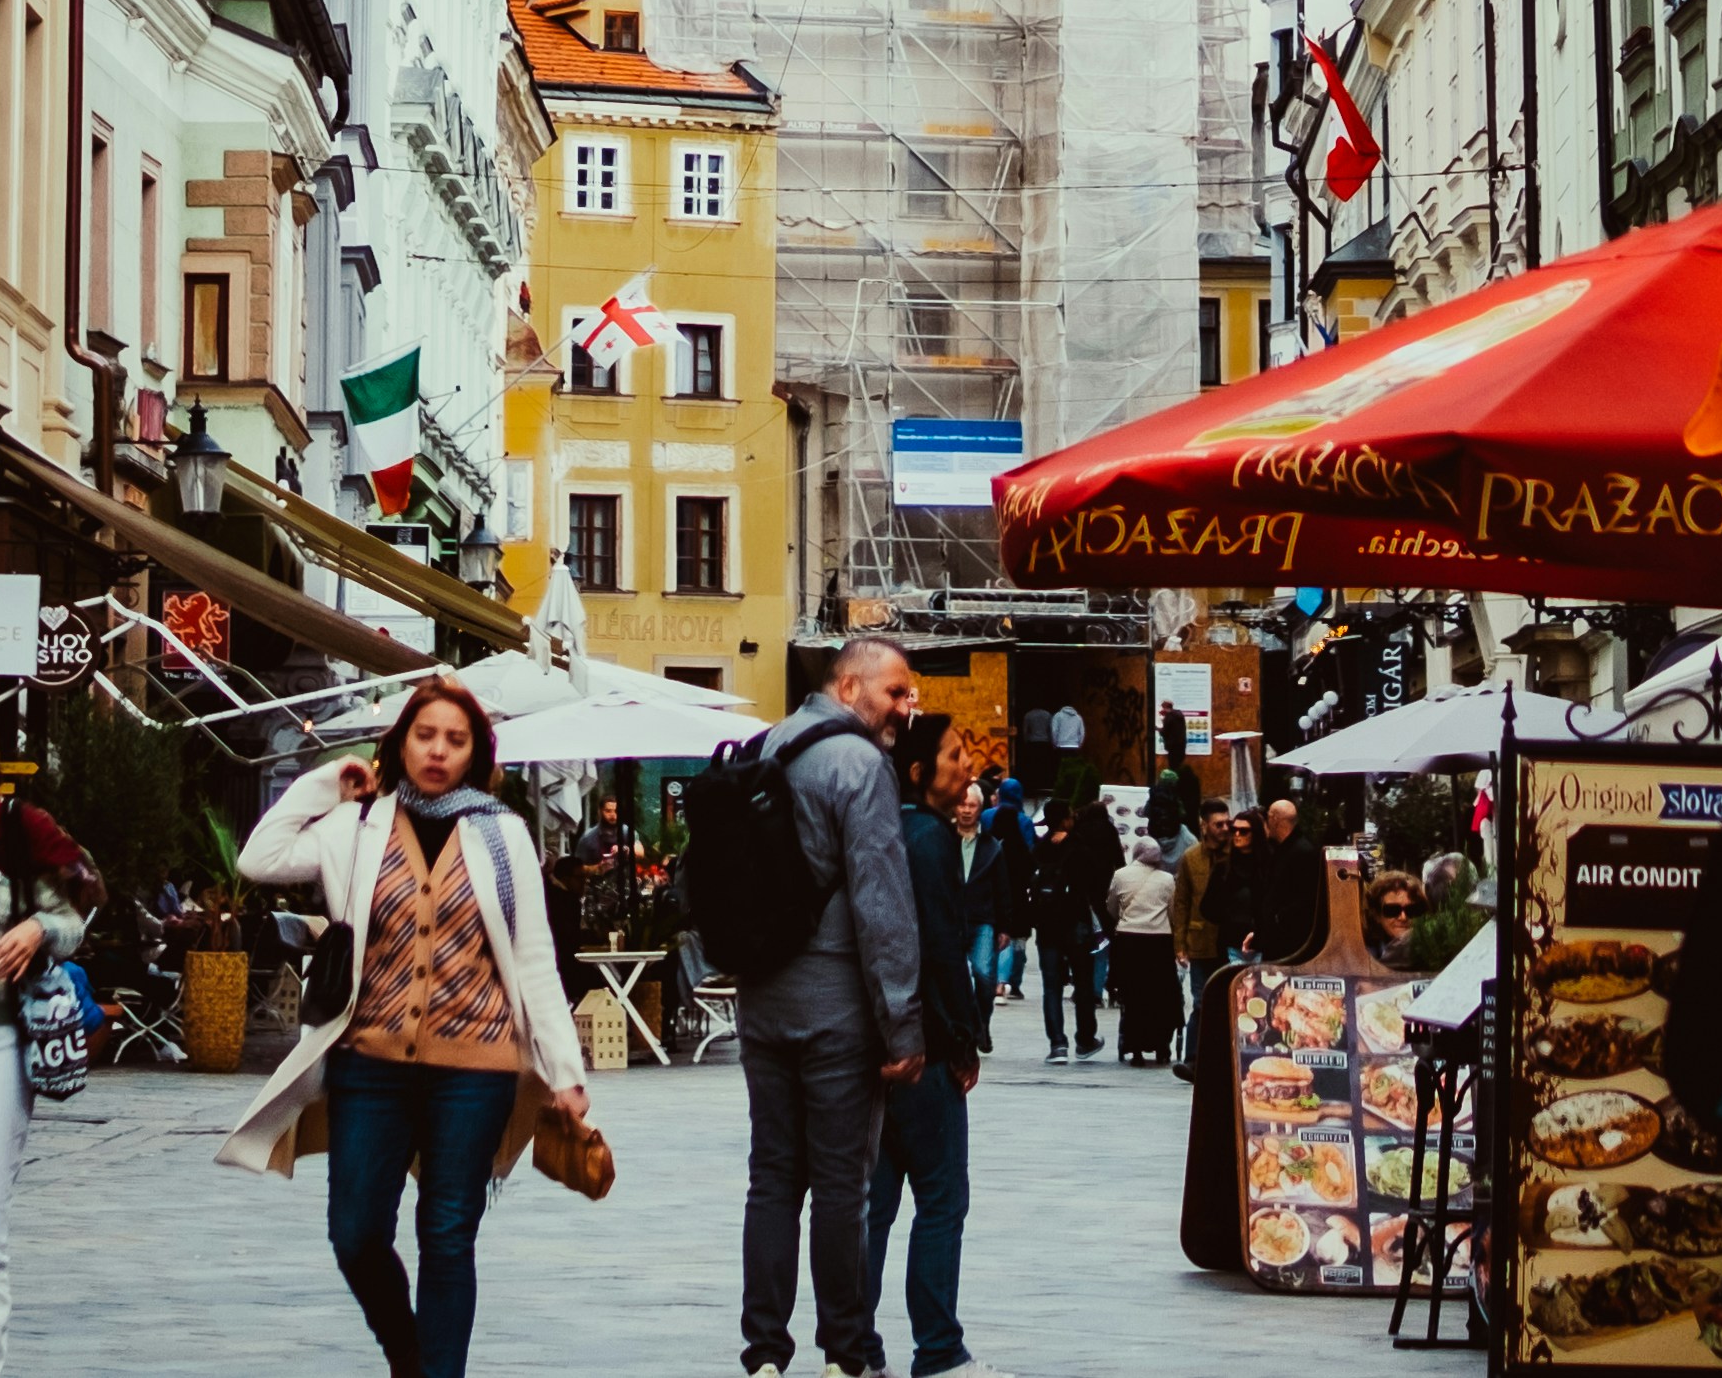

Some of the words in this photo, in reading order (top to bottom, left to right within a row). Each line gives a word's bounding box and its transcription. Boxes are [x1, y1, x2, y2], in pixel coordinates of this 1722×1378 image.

[662, 615, 723, 642] NOVA
[1560, 772, 1653, 816] Original
[1577, 864, 1614, 885] AIR
